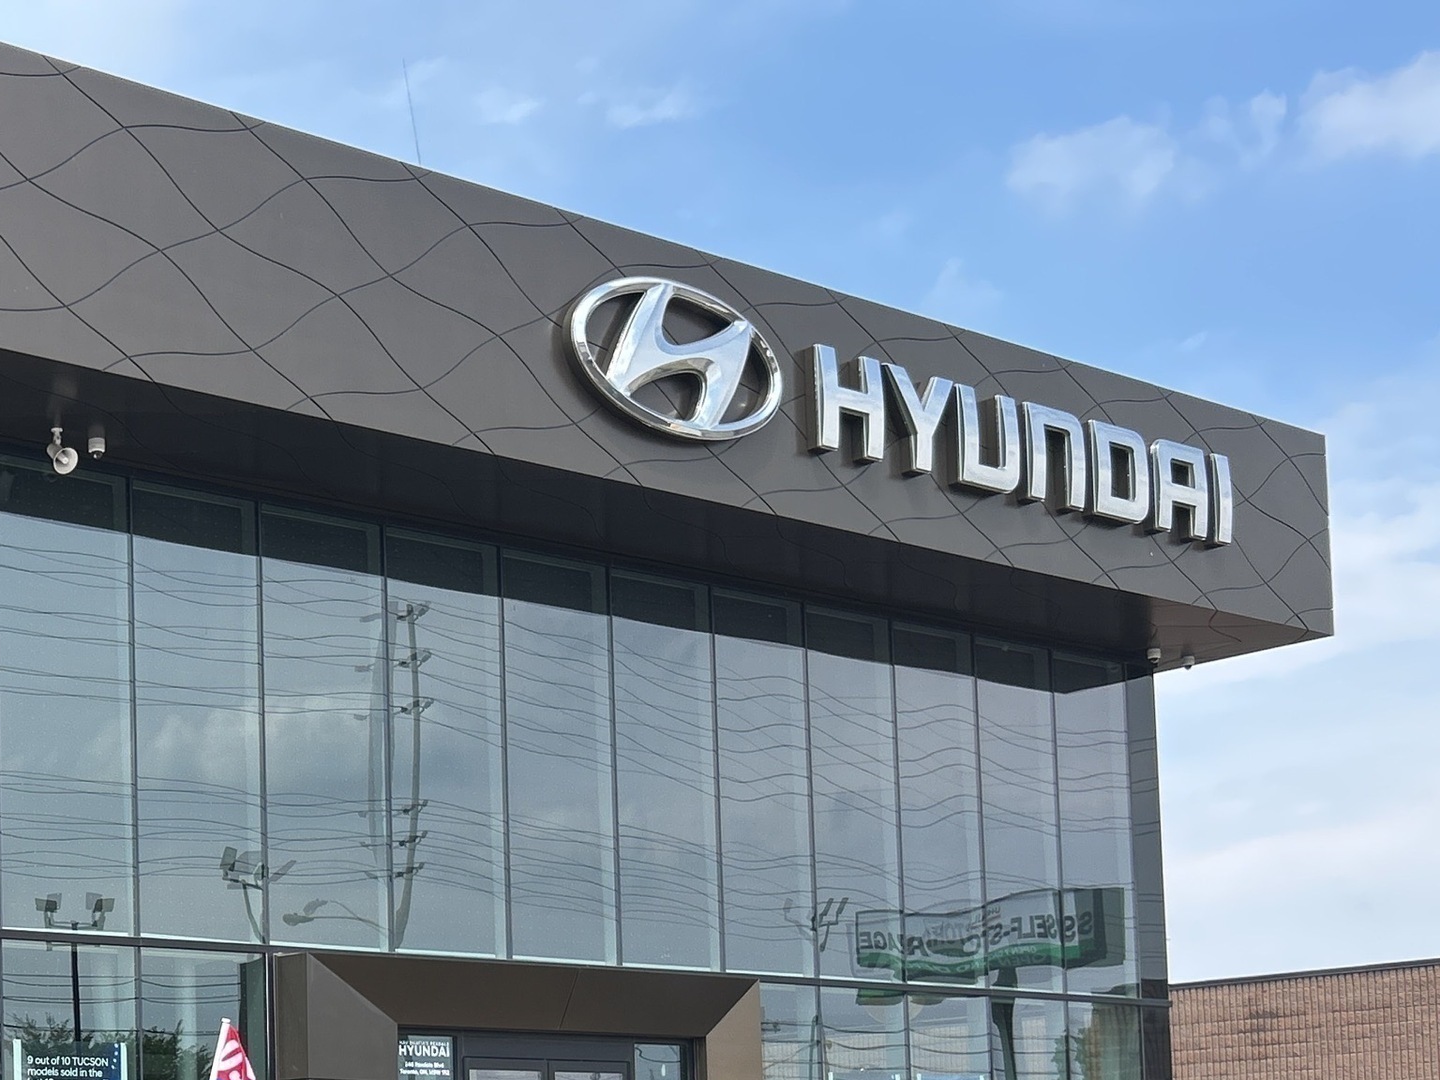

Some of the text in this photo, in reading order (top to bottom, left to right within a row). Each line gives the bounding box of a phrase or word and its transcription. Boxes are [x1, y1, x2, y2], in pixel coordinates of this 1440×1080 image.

[807, 342, 1233, 547] HYUNDAI
[399, 1045, 450, 1057] HYUNDAI
[27, 1055, 108, 1066] 9 out of 10 TUCSON
[27, 1067, 103, 1077] models sold in the
